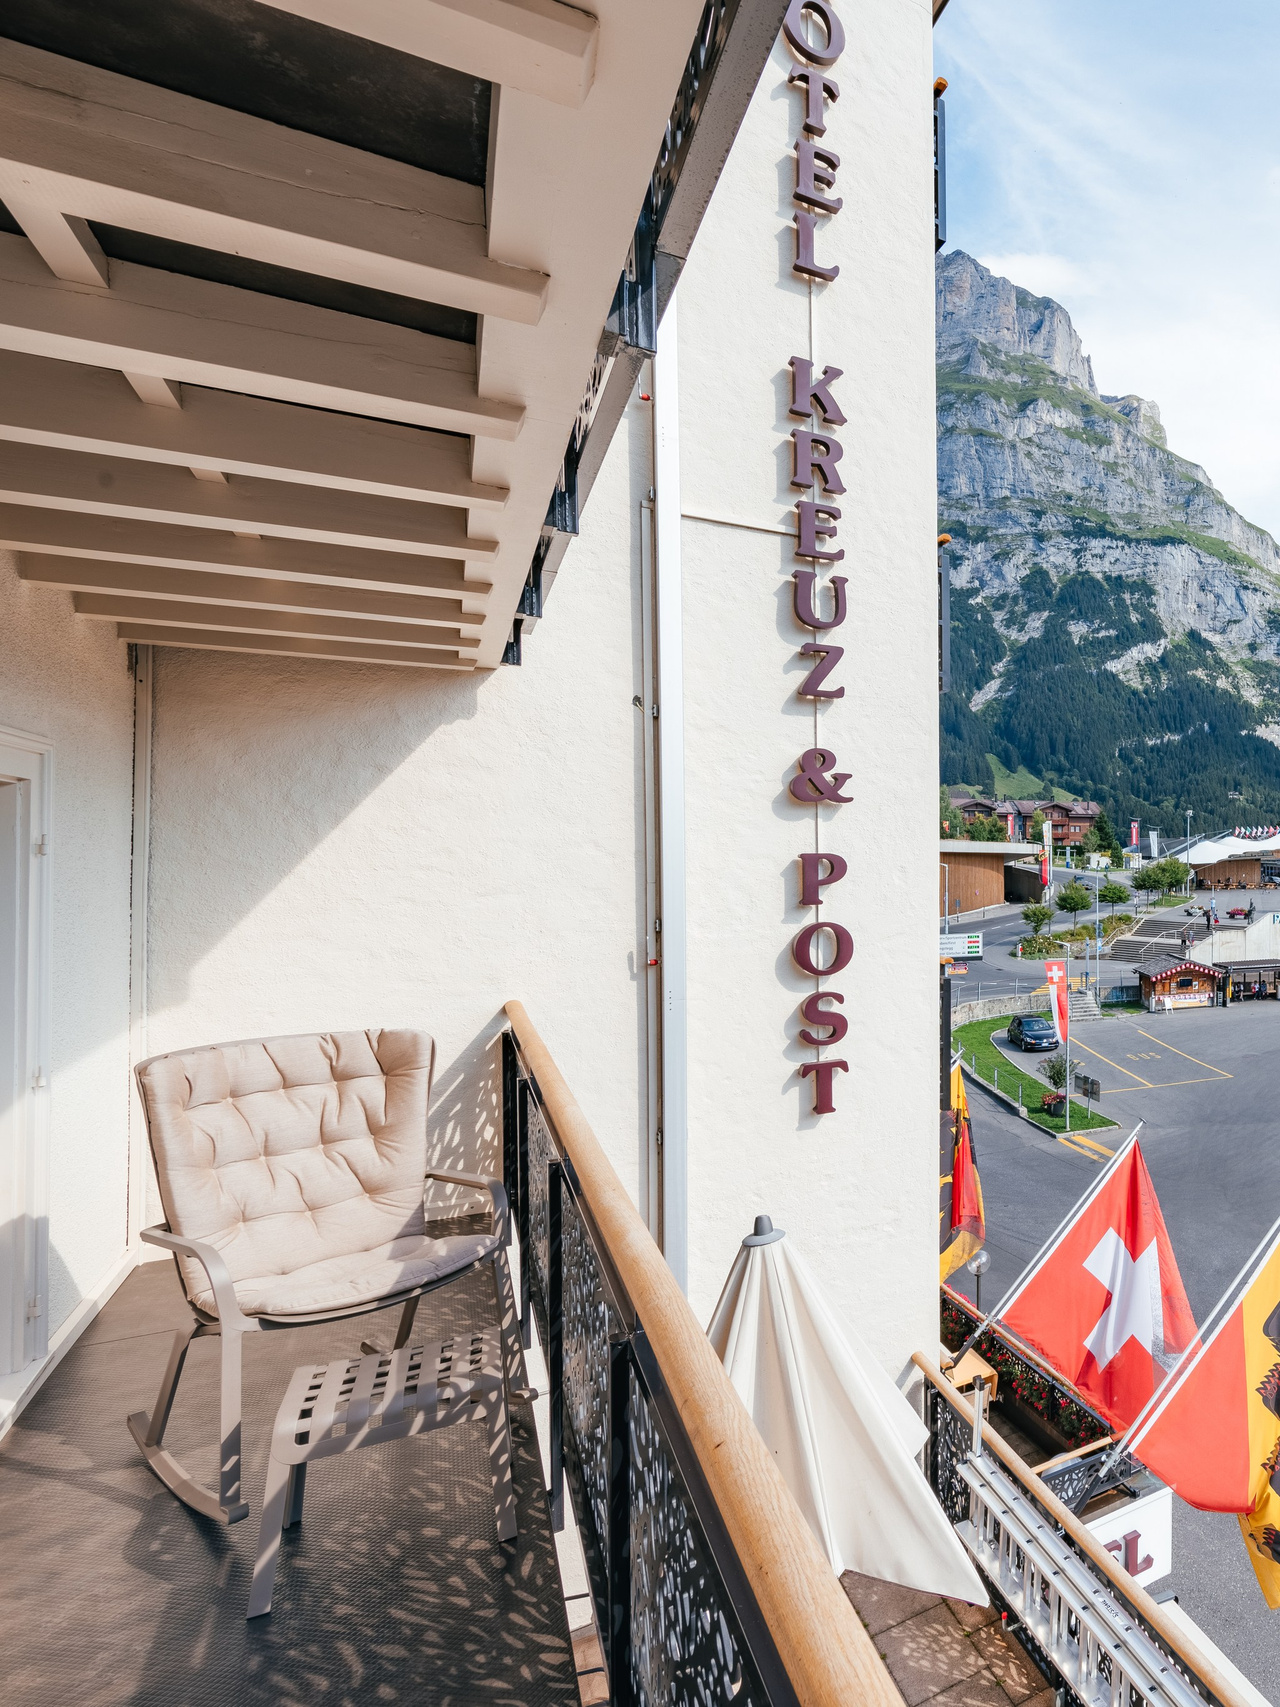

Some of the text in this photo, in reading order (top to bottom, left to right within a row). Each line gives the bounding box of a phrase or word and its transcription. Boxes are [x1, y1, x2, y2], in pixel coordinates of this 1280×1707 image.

[787, 355, 848, 698] KREUZ
[789, 747, 854, 804] &
[791, 853, 855, 1115] POST
[1126, 1052, 1162, 1060] BUS
